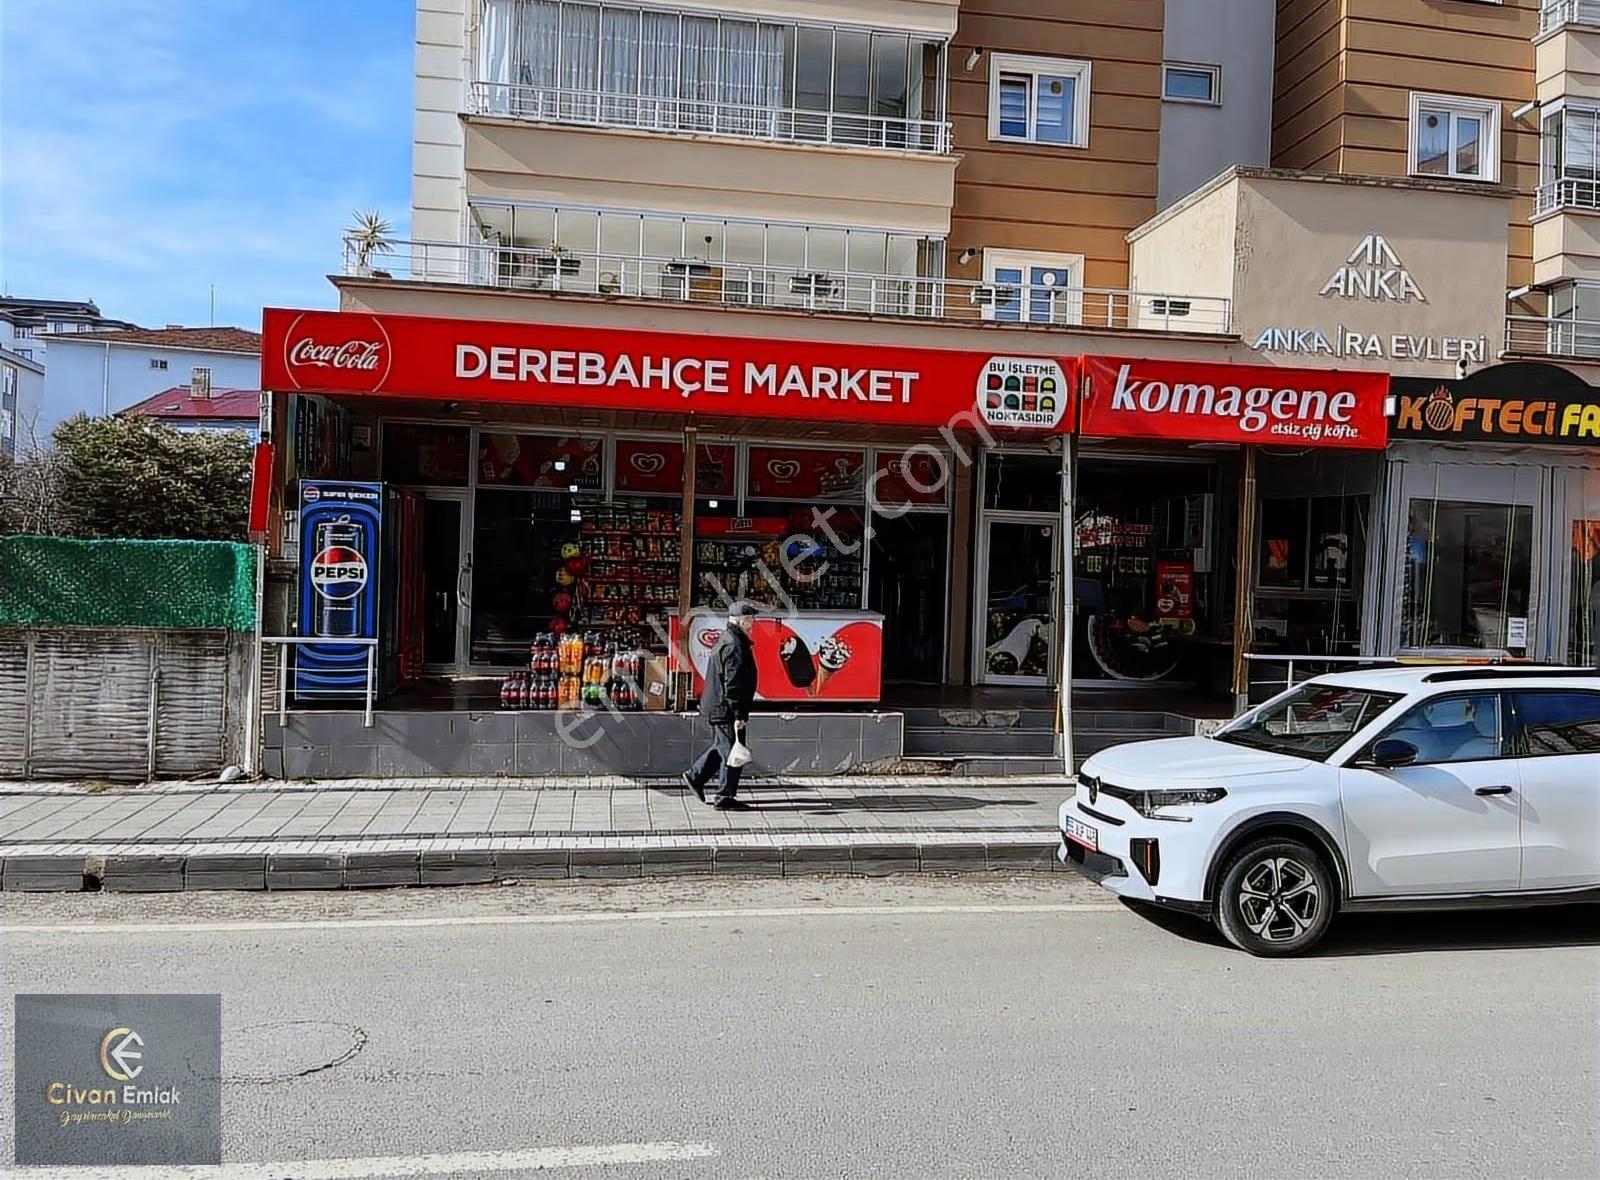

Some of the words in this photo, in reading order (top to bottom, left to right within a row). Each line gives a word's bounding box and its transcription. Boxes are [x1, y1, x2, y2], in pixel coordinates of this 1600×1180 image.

[1318, 266, 1426, 301] ANKA
[290, 337, 385, 370] Coca-Cola
[1251, 326, 1334, 354] ANKA
[1391, 334, 1487, 362] EVLERİ
[455, 344, 730, 398] DEREBAHÇE
[744, 361, 920, 403] MARKET
[989, 362, 1005, 372] BU
[1111, 364, 1356, 432] komagene
[987, 411, 1054, 423] NOKTASIDIR
[1270, 422, 1301, 435] etsiz
[1324, 423, 1358, 439] köfte
[314, 566, 365, 579] PEPSI
